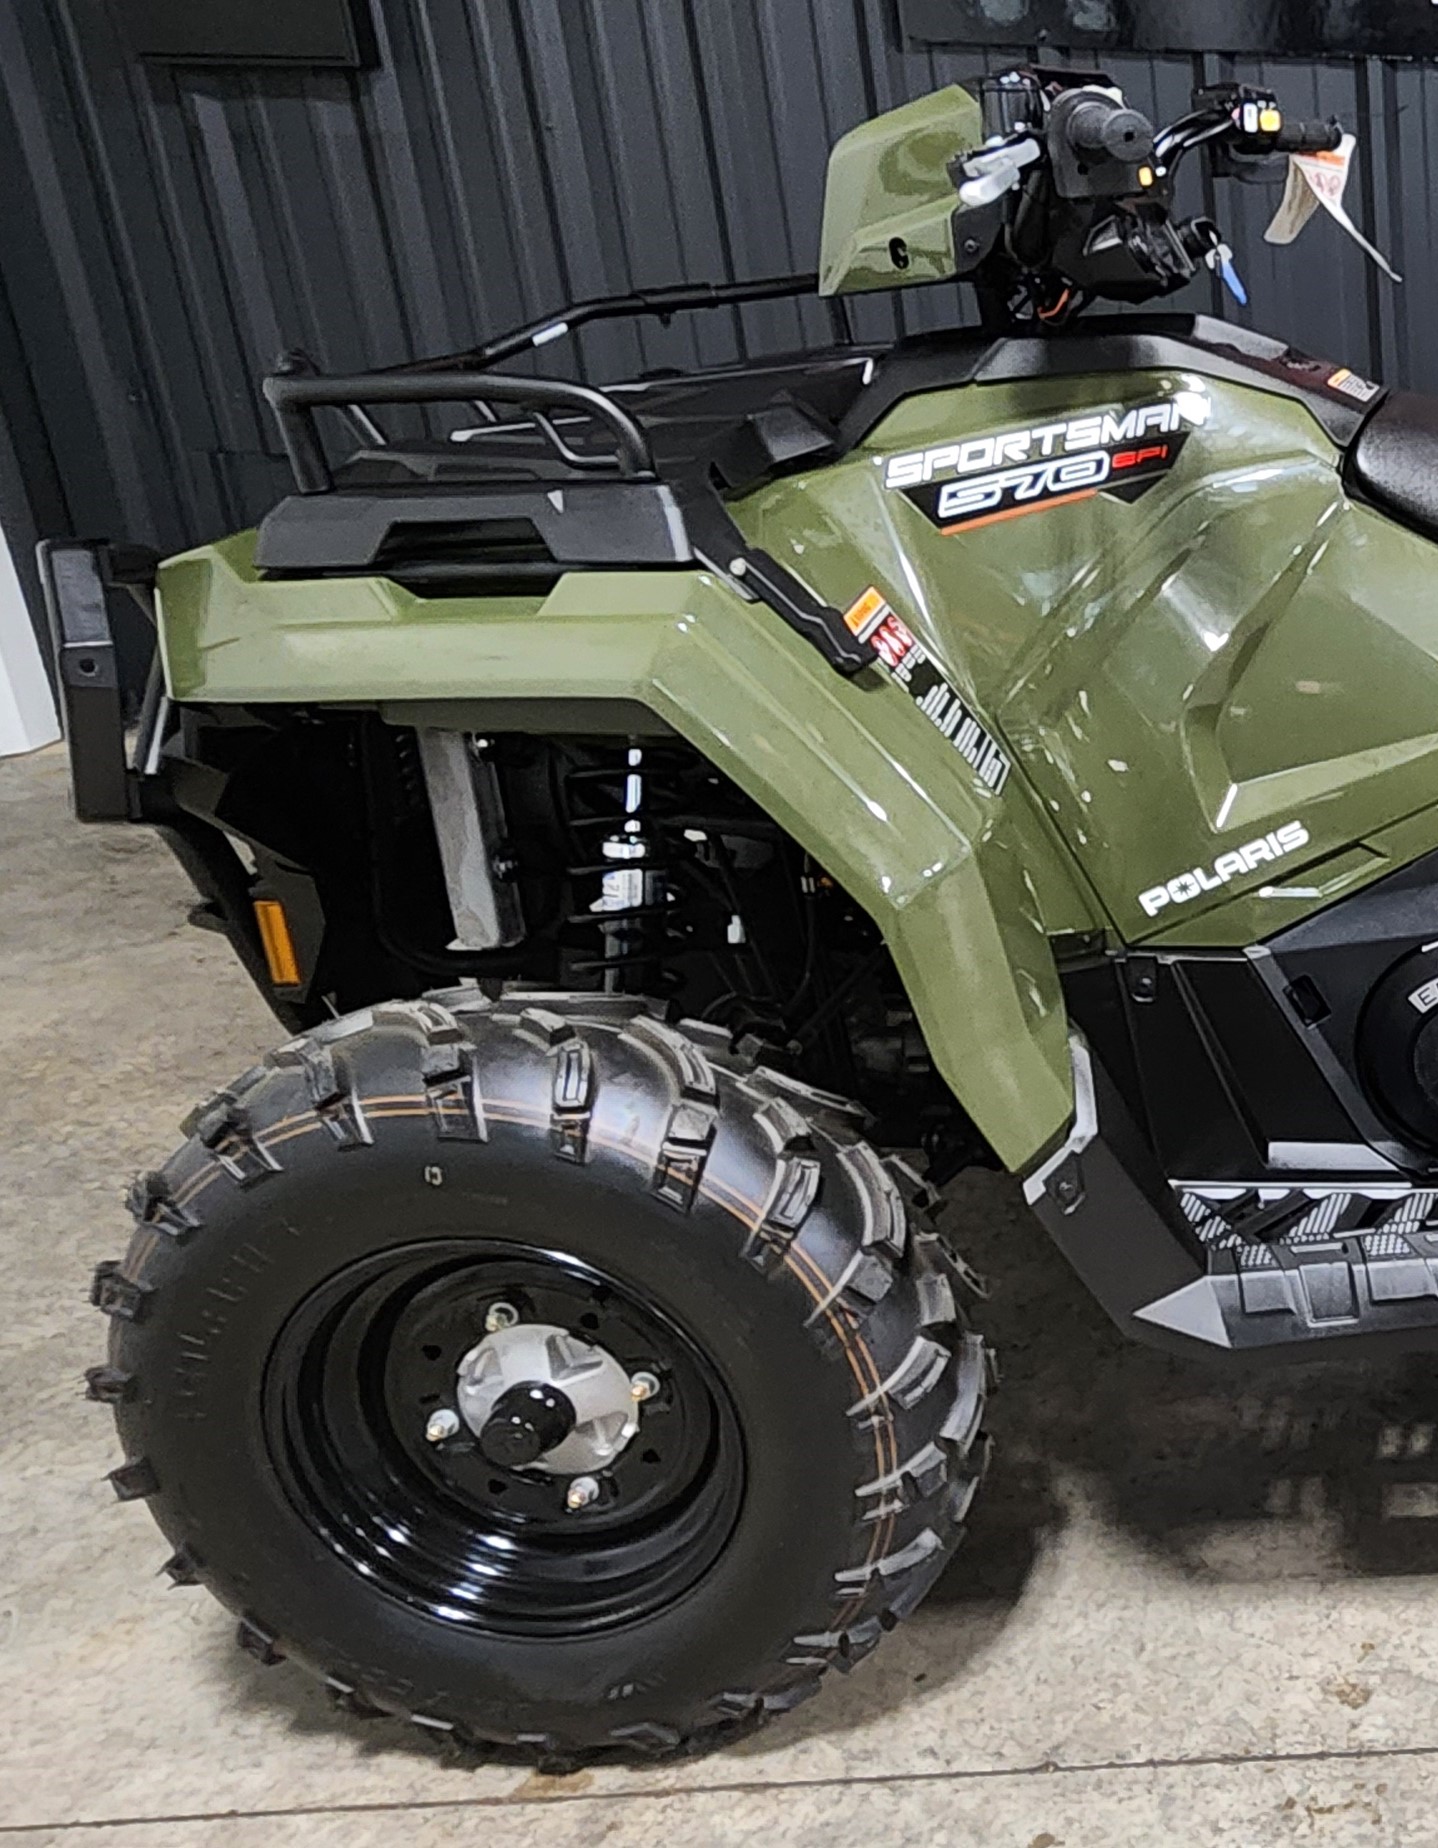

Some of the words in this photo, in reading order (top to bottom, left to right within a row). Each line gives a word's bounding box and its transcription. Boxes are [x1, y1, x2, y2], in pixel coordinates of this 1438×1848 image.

[885, 396, 1211, 488] SPORTSMAN
[938, 450, 1109, 518] 570
[1138, 820, 1309, 917] POLARIS
